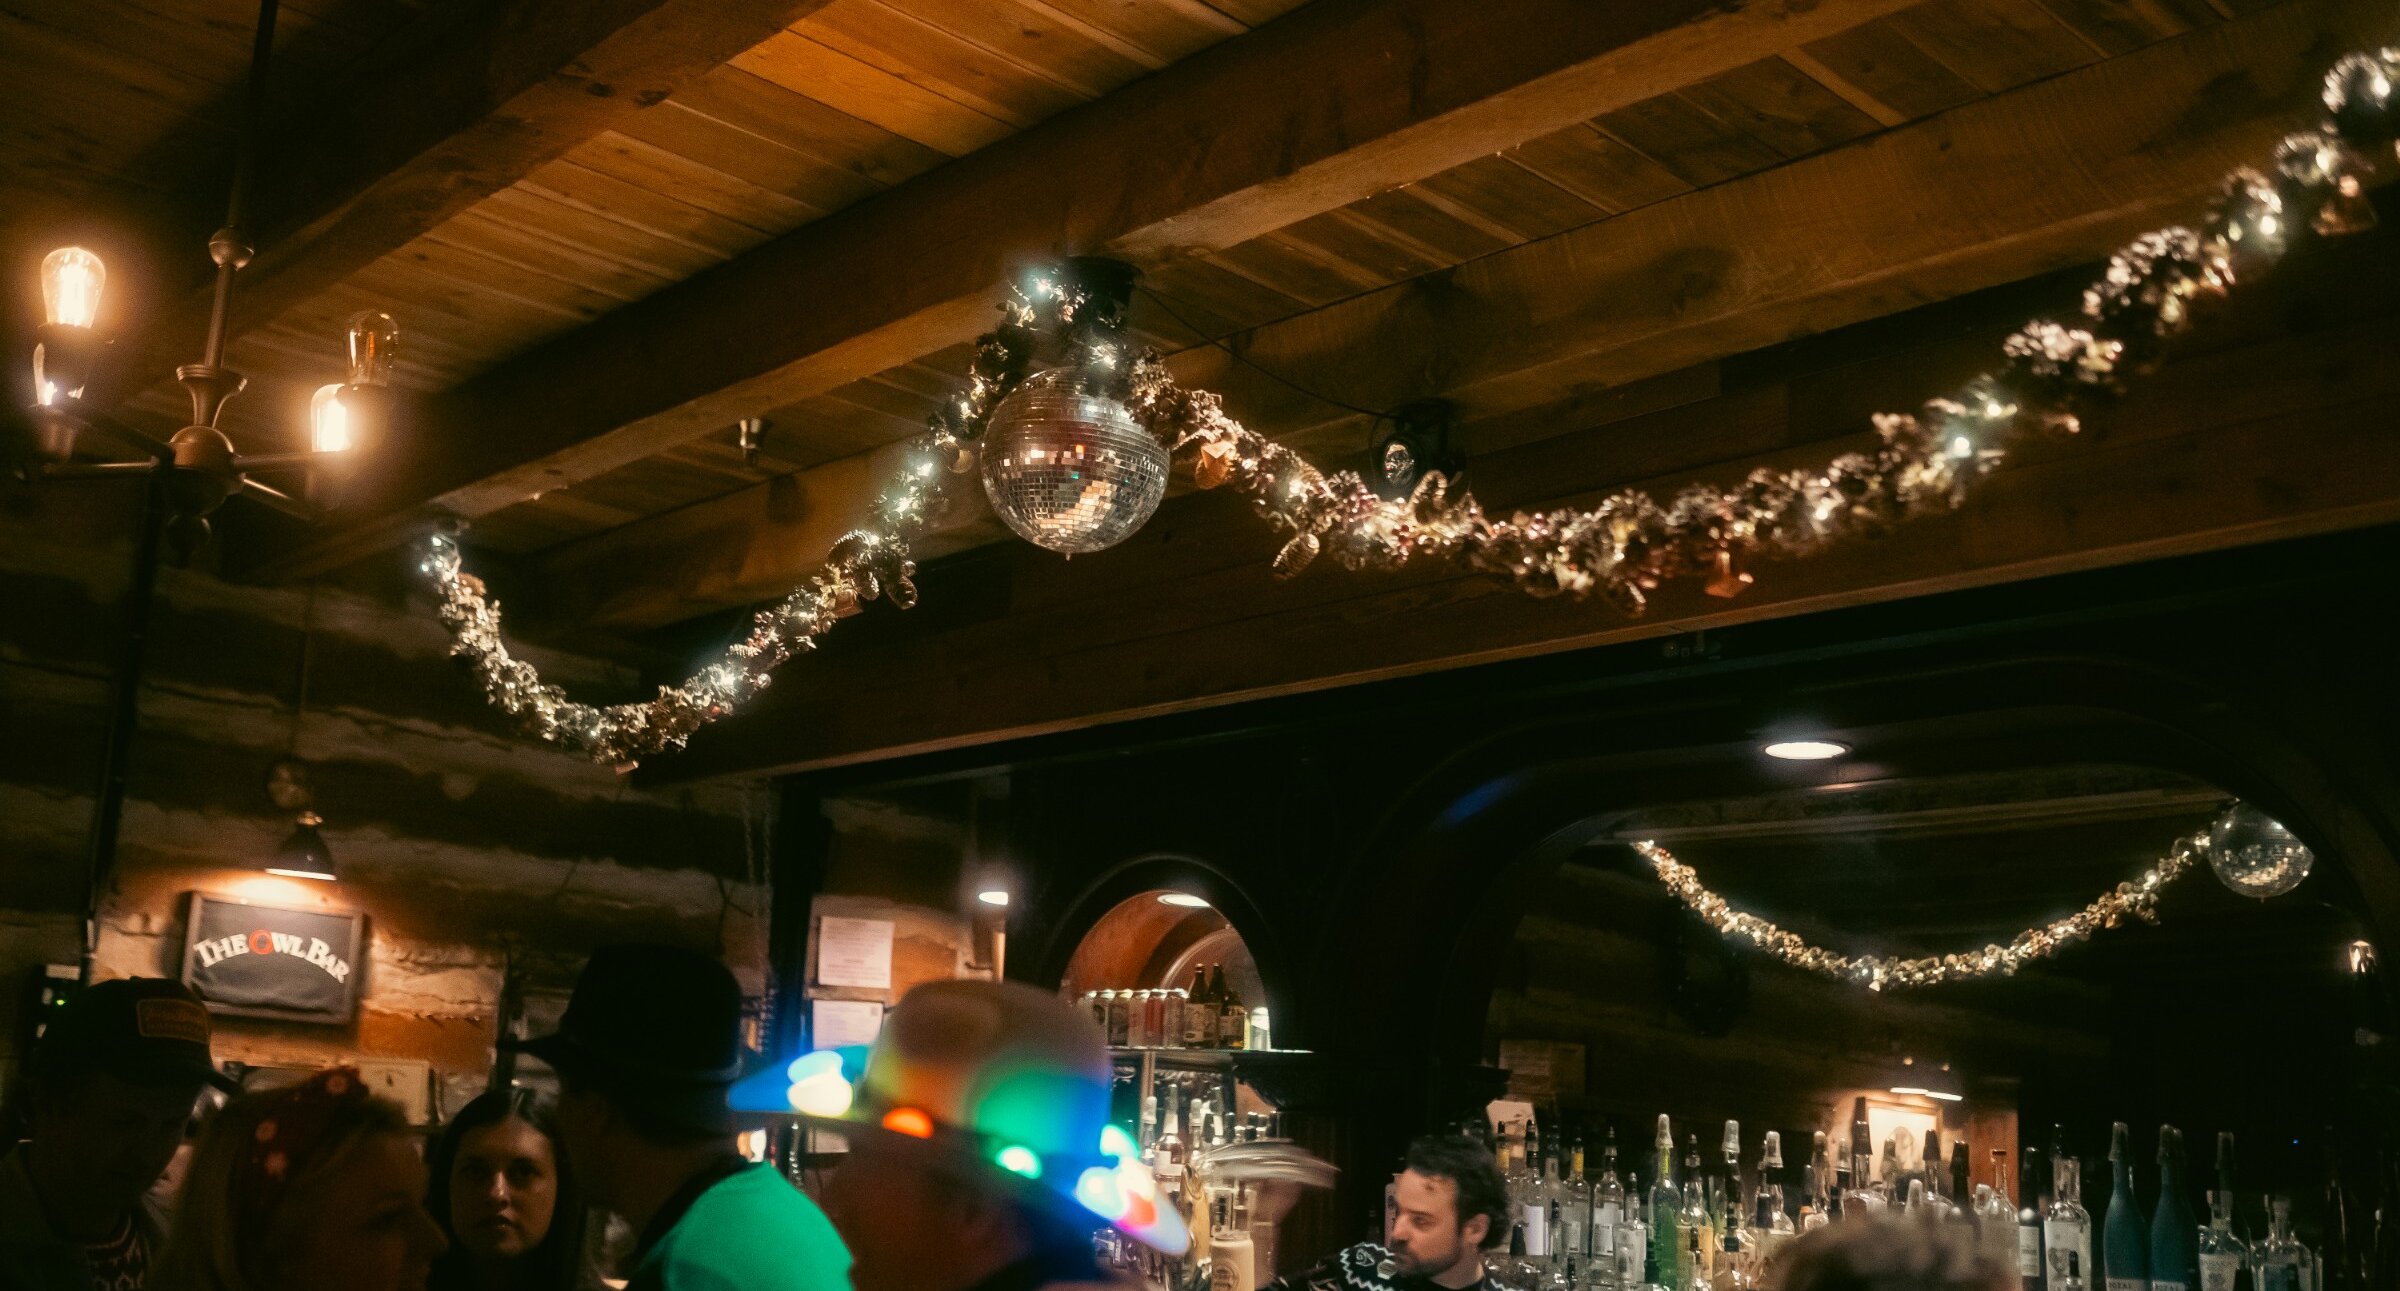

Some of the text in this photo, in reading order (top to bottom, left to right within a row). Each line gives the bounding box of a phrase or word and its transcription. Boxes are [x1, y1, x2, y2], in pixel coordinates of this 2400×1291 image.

[193, 929, 350, 983] THE OWL BAR
